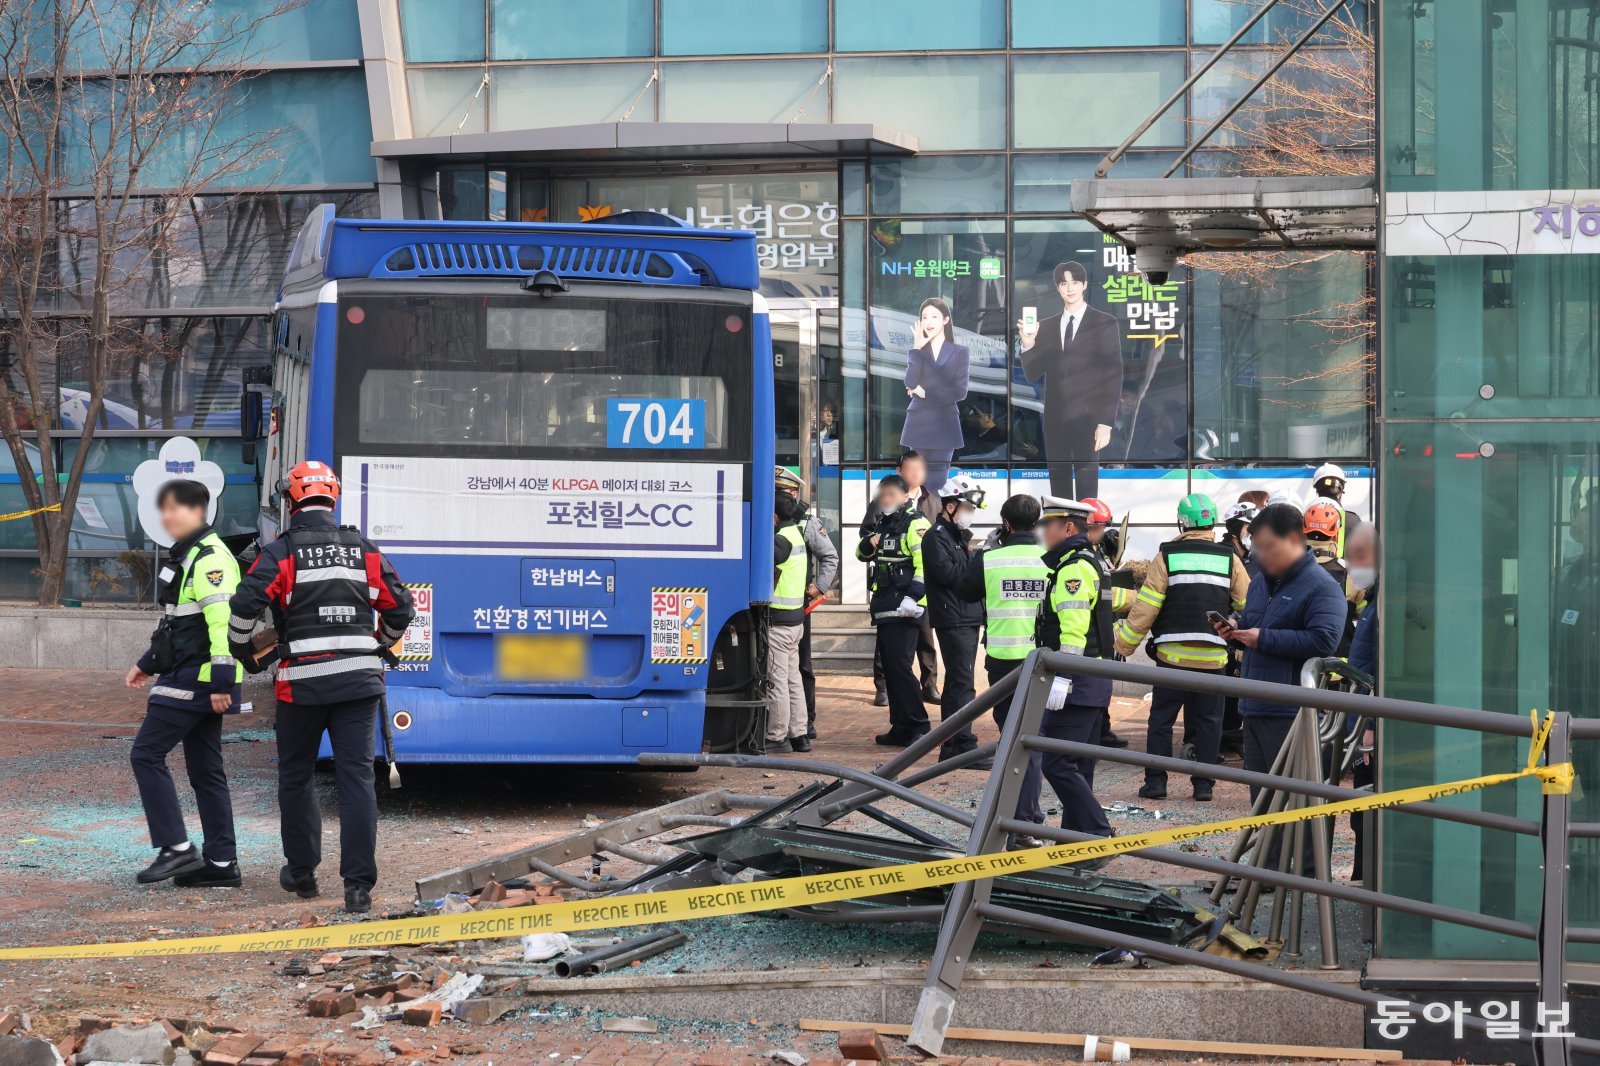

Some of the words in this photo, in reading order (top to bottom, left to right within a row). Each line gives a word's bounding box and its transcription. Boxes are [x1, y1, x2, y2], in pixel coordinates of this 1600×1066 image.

[1127, 302, 1179, 330] 만남
[617, 402, 694, 445] 704
[466, 476, 517, 491] 강남에서
[519, 477, 550, 492] 40분
[552, 478, 599, 492] KLPGA
[601, 478, 639, 493] 메이저
[641, 479, 666, 493] 대회
[668, 480, 693, 493] 코스
[546, 500, 694, 529] 포천힐스CC
[297, 545, 362, 559] 119구조대
[308, 557, 355, 567] RESCUE
[530, 568, 602, 587] 한남버스
[1004, 580, 1044, 591] 교통경찰
[653, 594, 679, 617] 주의
[473, 604, 528, 630] 친환경
[533, 608, 608, 630] 전기버스
[653, 619, 680, 631] 우회전시
[653, 632, 679, 644] 끼어들면
[683, 667, 698, 675] EV
